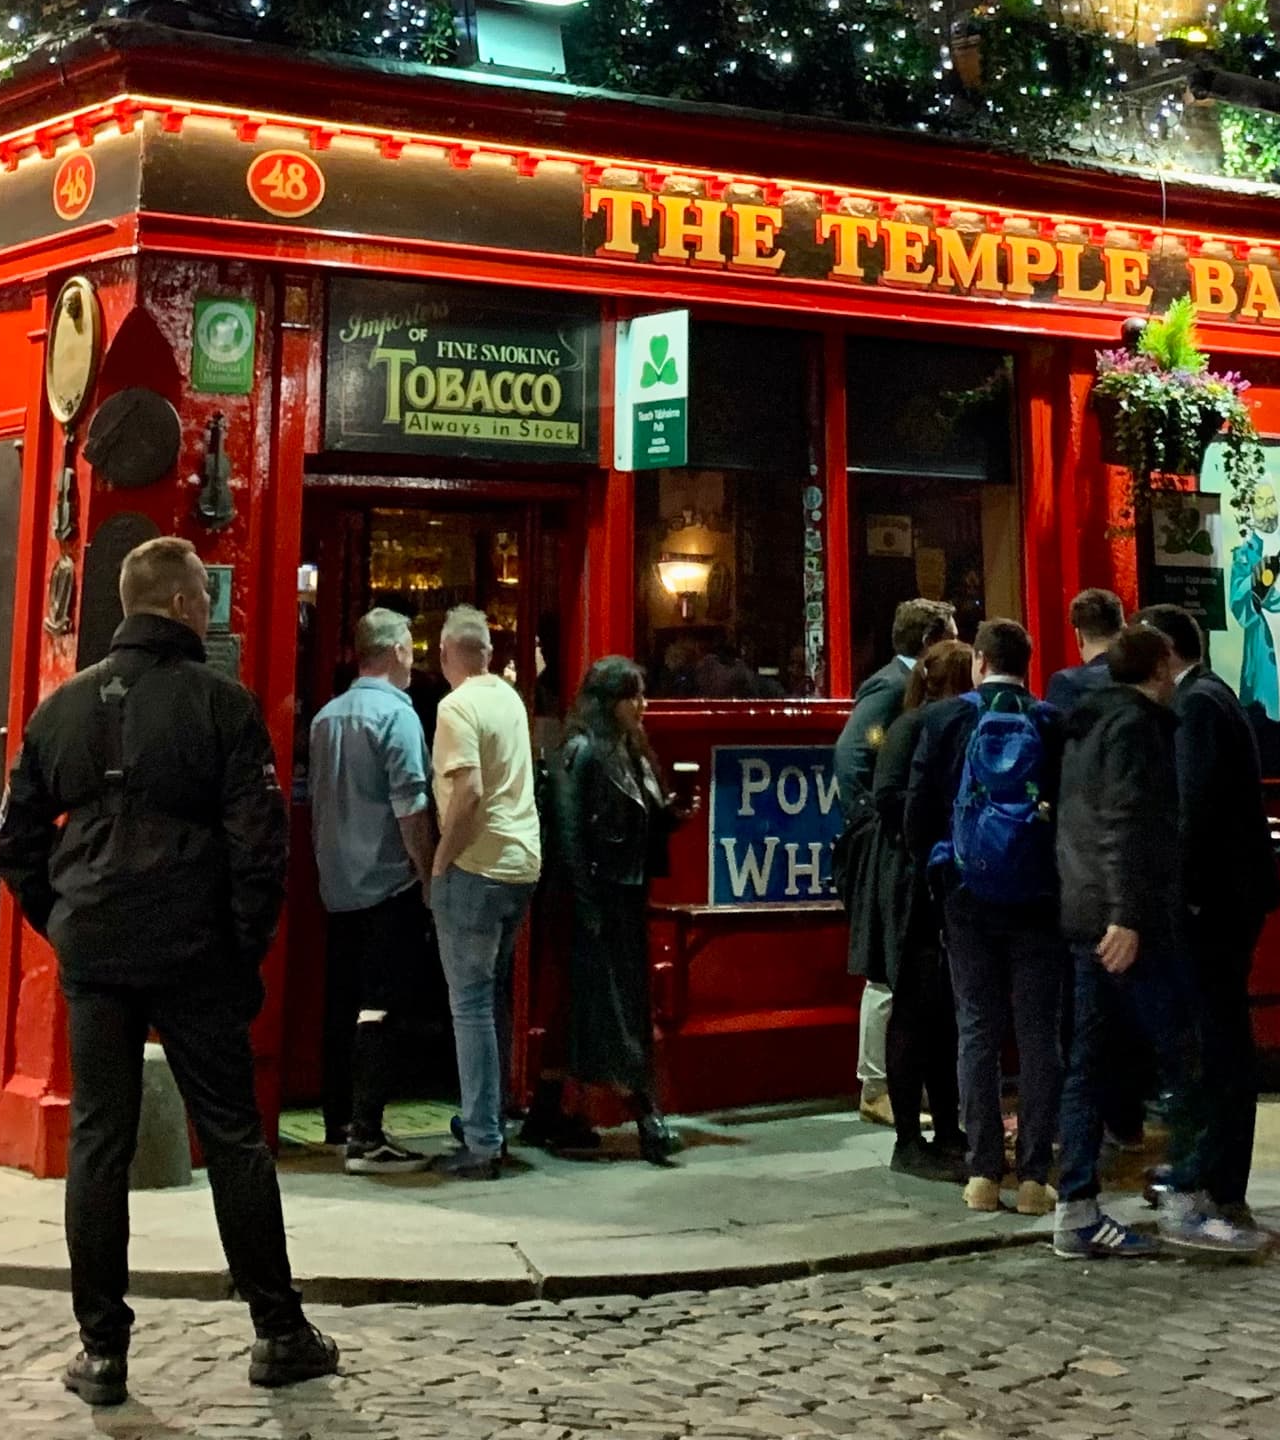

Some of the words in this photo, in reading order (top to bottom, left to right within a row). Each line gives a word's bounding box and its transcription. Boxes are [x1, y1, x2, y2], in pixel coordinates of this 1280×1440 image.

[60, 163, 88, 209] 48
[260, 161, 308, 200] 48
[589, 186, 787, 270] THE
[818, 211, 1156, 310] TEMPLE
[339, 301, 449, 346] Importers
[408, 327, 428, 343] OF
[437, 340, 479, 361] FINE
[480, 343, 561, 368] SMOKING
[367, 347, 563, 425] TOBACCO
[407, 413, 482, 438] Always
[492, 419, 511, 436] in
[518, 419, 577, 442] Stock
[720, 836, 839, 898] WH
